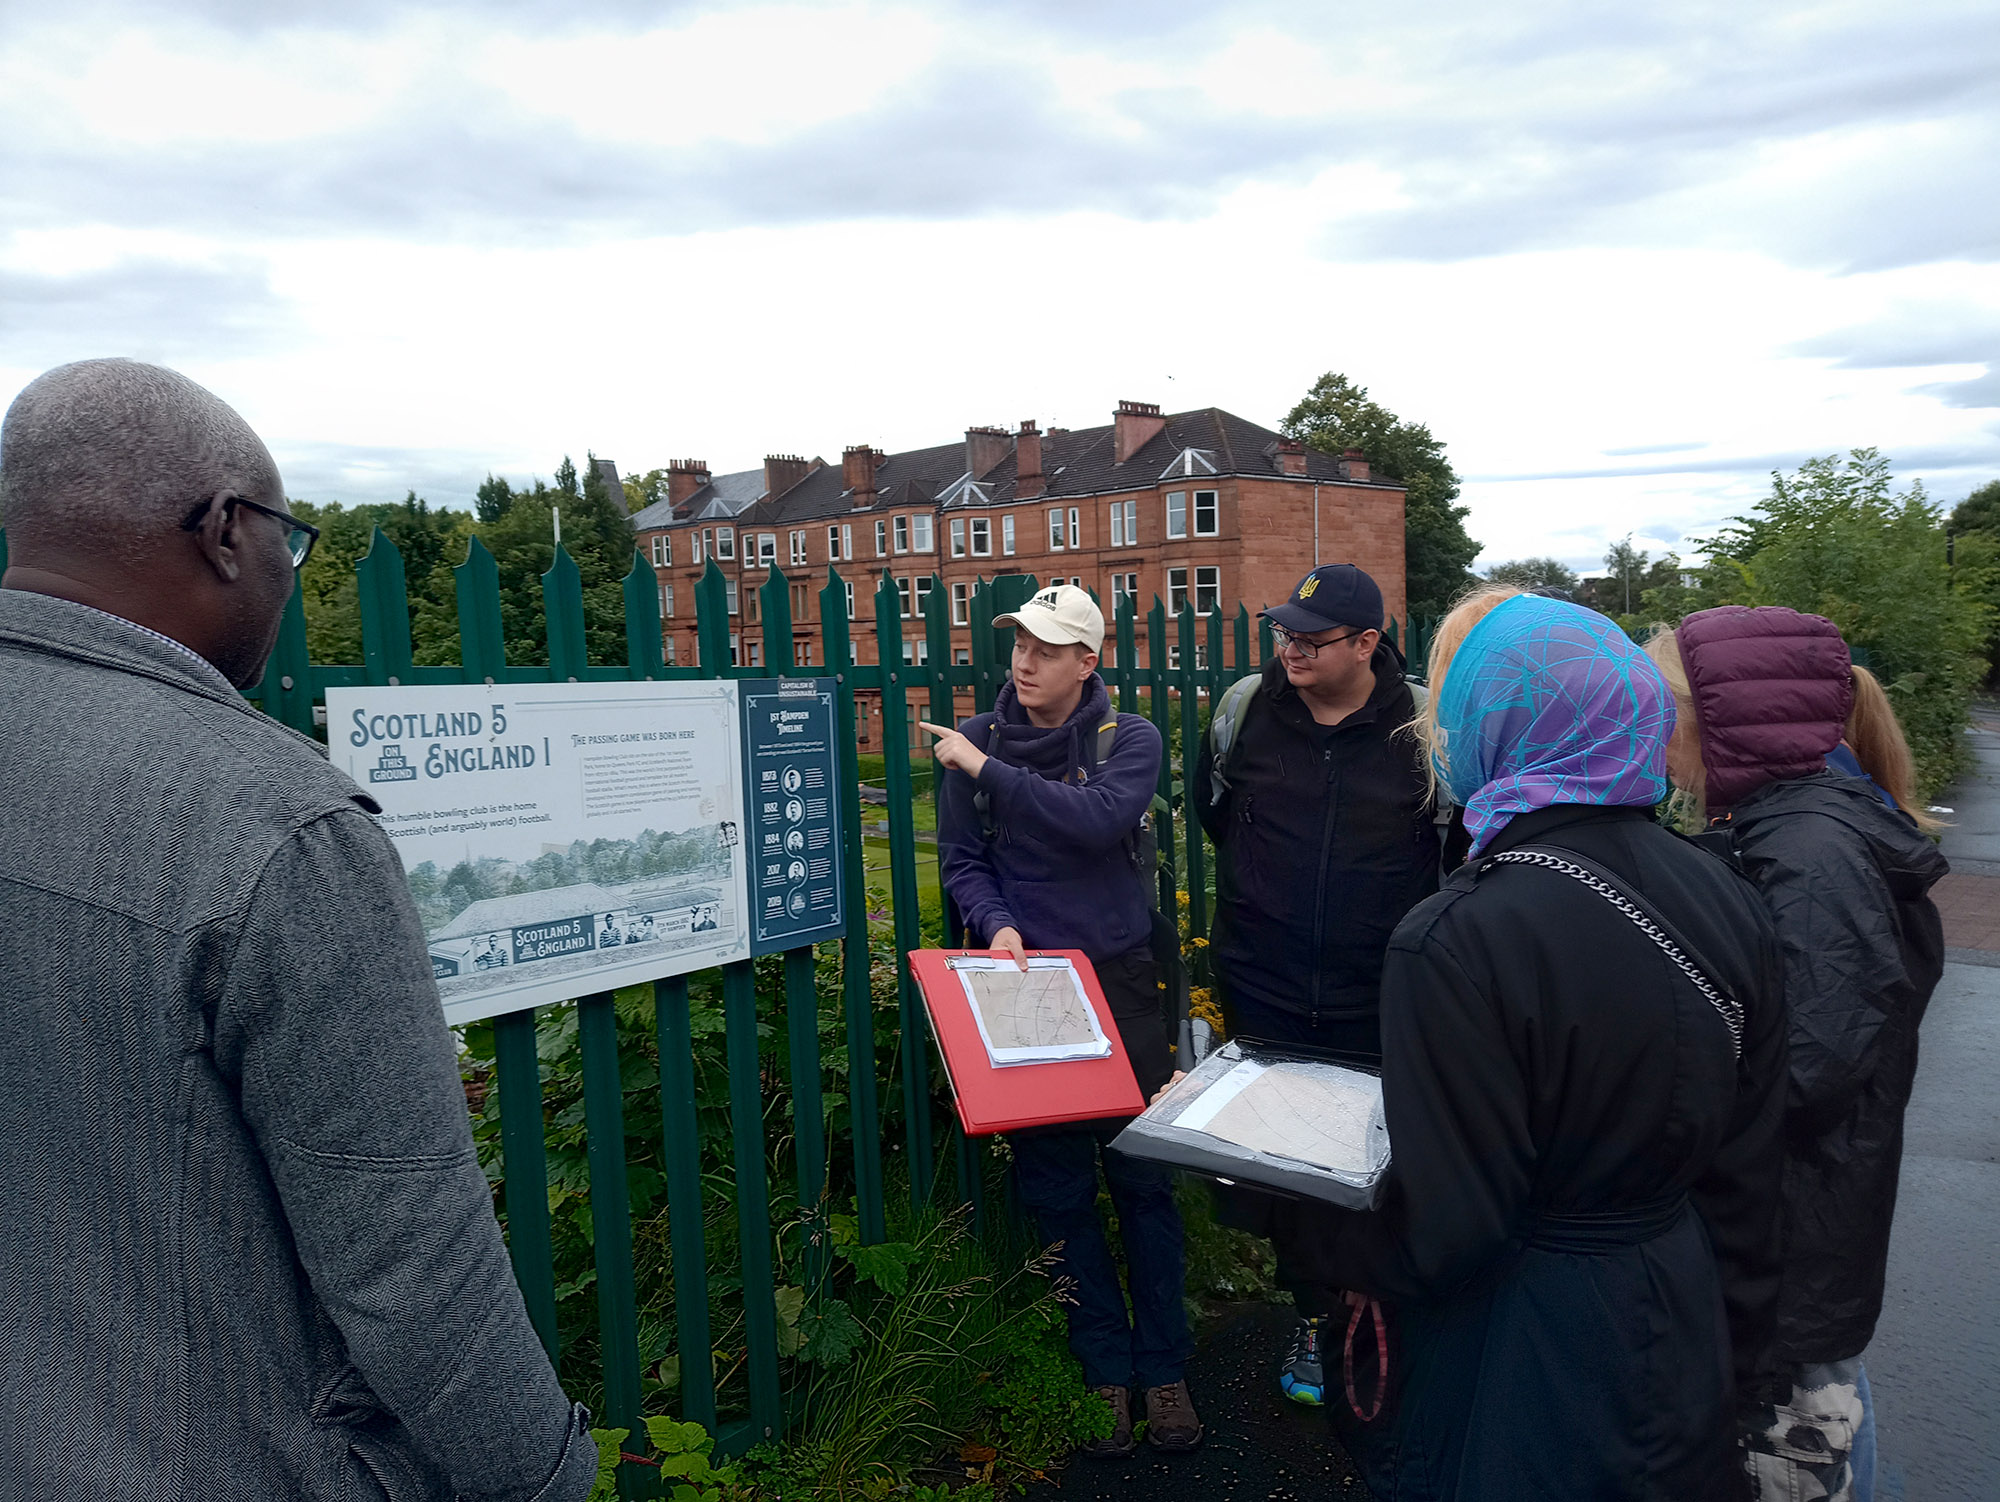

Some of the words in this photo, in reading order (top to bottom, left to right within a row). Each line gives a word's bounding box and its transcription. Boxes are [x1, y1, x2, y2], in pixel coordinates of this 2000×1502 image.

[781, 682, 808, 690] CAPITALISM
[350, 708, 483, 748] SCOTLAND
[491, 704, 507, 735] 5
[776, 723, 804, 736] TIMELINE
[570, 734, 586, 748] THE
[588, 734, 619, 745] PASSING
[620, 733, 641, 743] GAME
[642, 732, 657, 741] WAS
[659, 731, 677, 741] BORN
[679, 730, 695, 739] HERE
[385, 747, 398, 758] ON
[425, 743, 536, 778] ENGLAND
[381, 758, 404, 769] THIS
[372, 769, 413, 781] GROUND
[375, 814, 395, 824] This
[397, 812, 432, 823] humble
[433, 808, 469, 819] bowling
[470, 806, 489, 815] club
[490, 805, 497, 813] is
[498, 803, 513, 812] the
[514, 802, 537, 811] home
[388, 824, 427, 838] Scottish
[428, 824, 449, 836] (and
[450, 819, 488, 834] arguably
[489, 816, 518, 829] world)
[518, 813, 552, 825] football.
[767, 863, 781, 875] 2017
[515, 925, 571, 947] SCOTLAND
[573, 920, 581, 934] 5
[537, 937, 586, 957] ENGLAND
